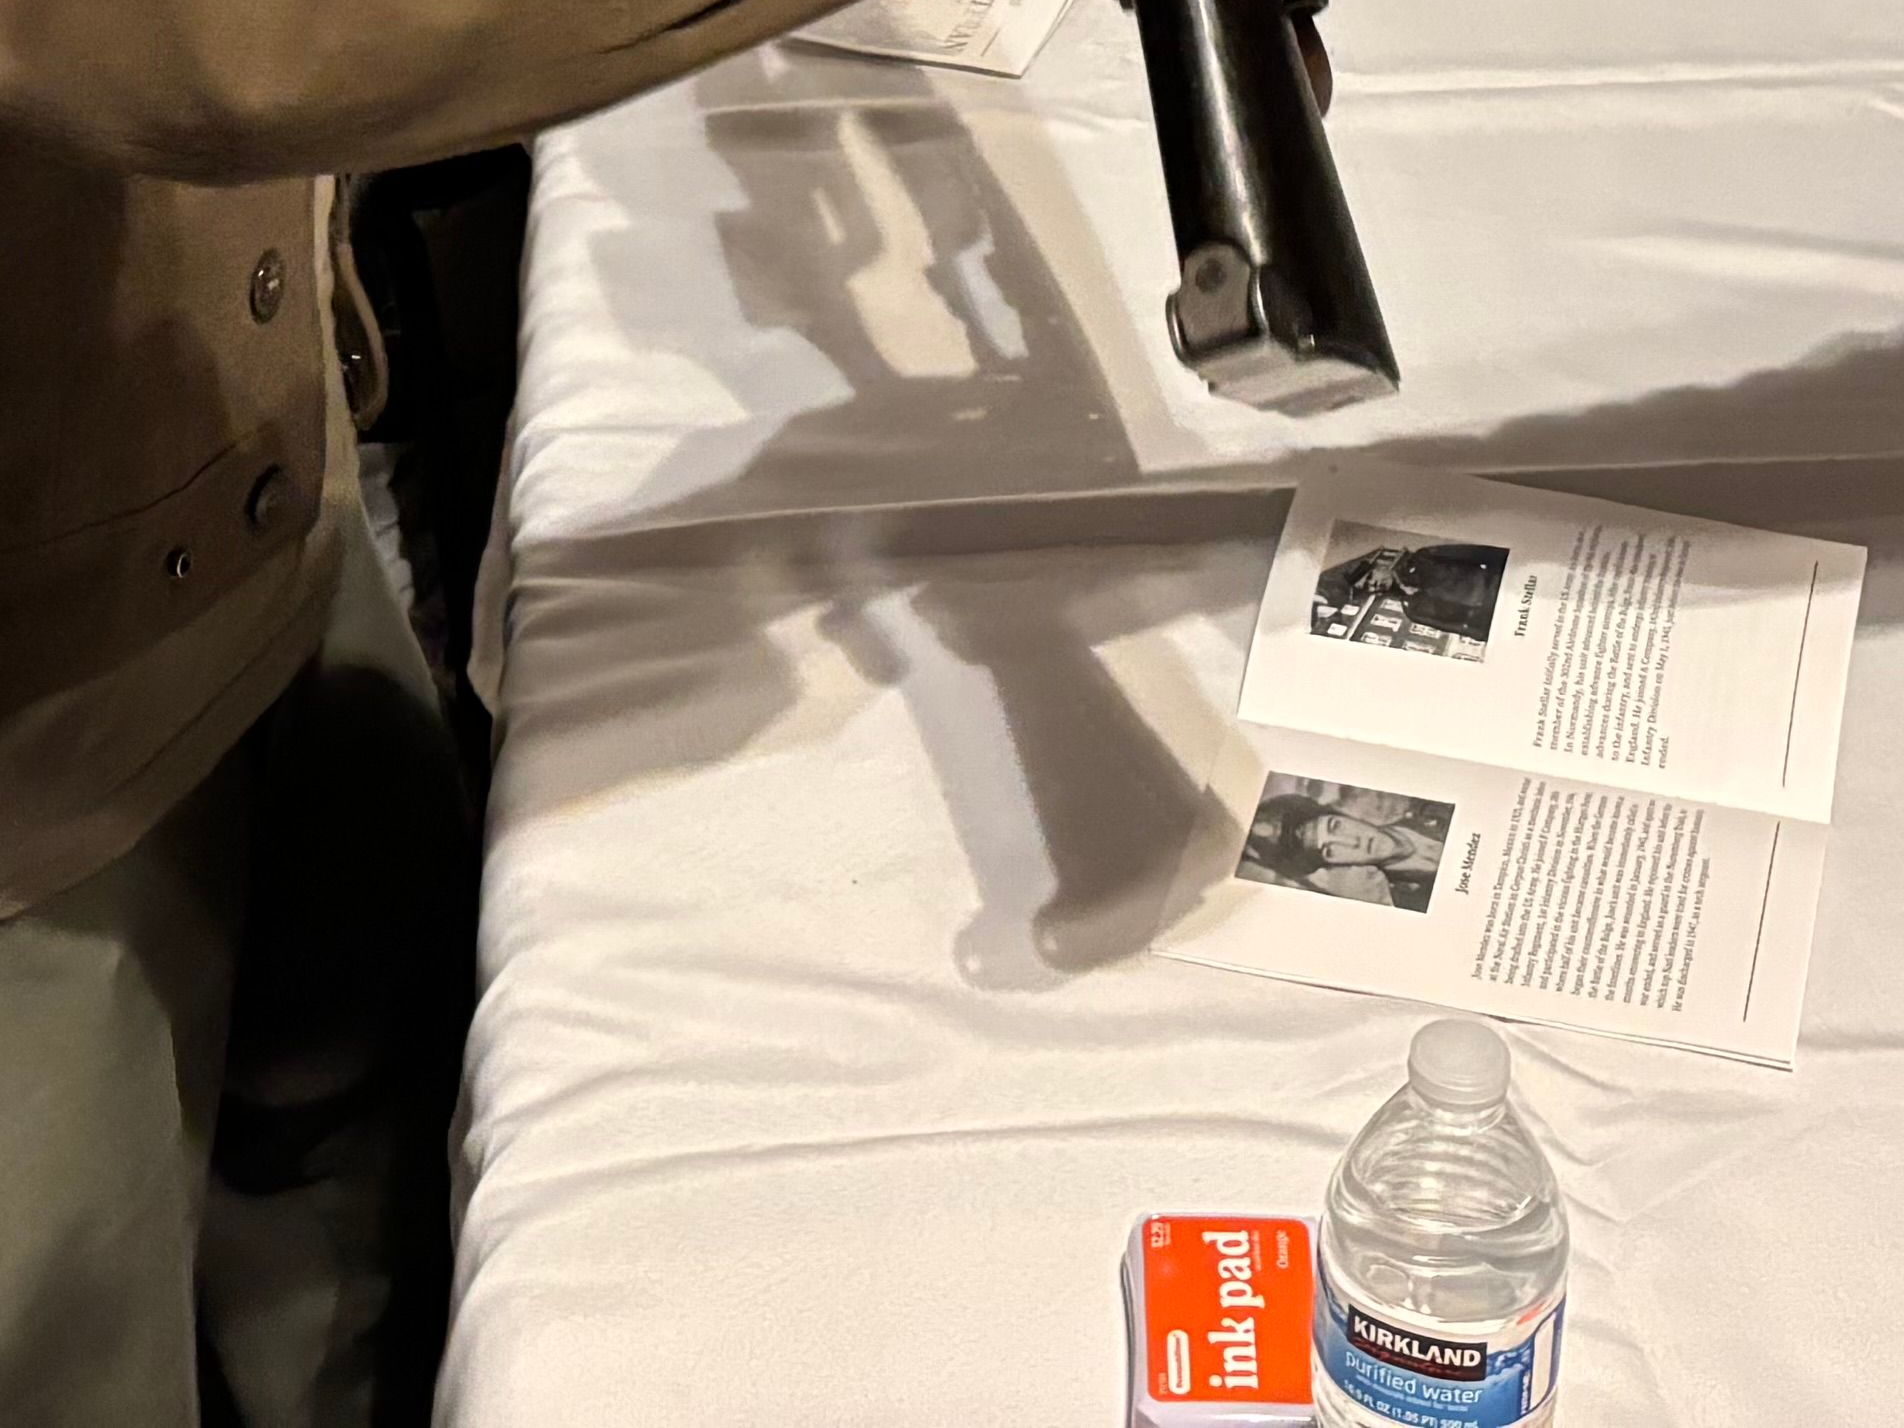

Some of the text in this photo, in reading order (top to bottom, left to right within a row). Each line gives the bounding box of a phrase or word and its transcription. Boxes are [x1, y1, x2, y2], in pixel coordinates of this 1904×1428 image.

[1513, 574, 1537, 636] Frank Stellar
[1454, 832, 1480, 895] Jose Mendez
[1201, 1229, 1265, 1389] ink pad
[1353, 1314, 1482, 1367] KIRKLAND
[1345, 1351, 1417, 1395] purified
[1422, 1387, 1484, 1404] water
